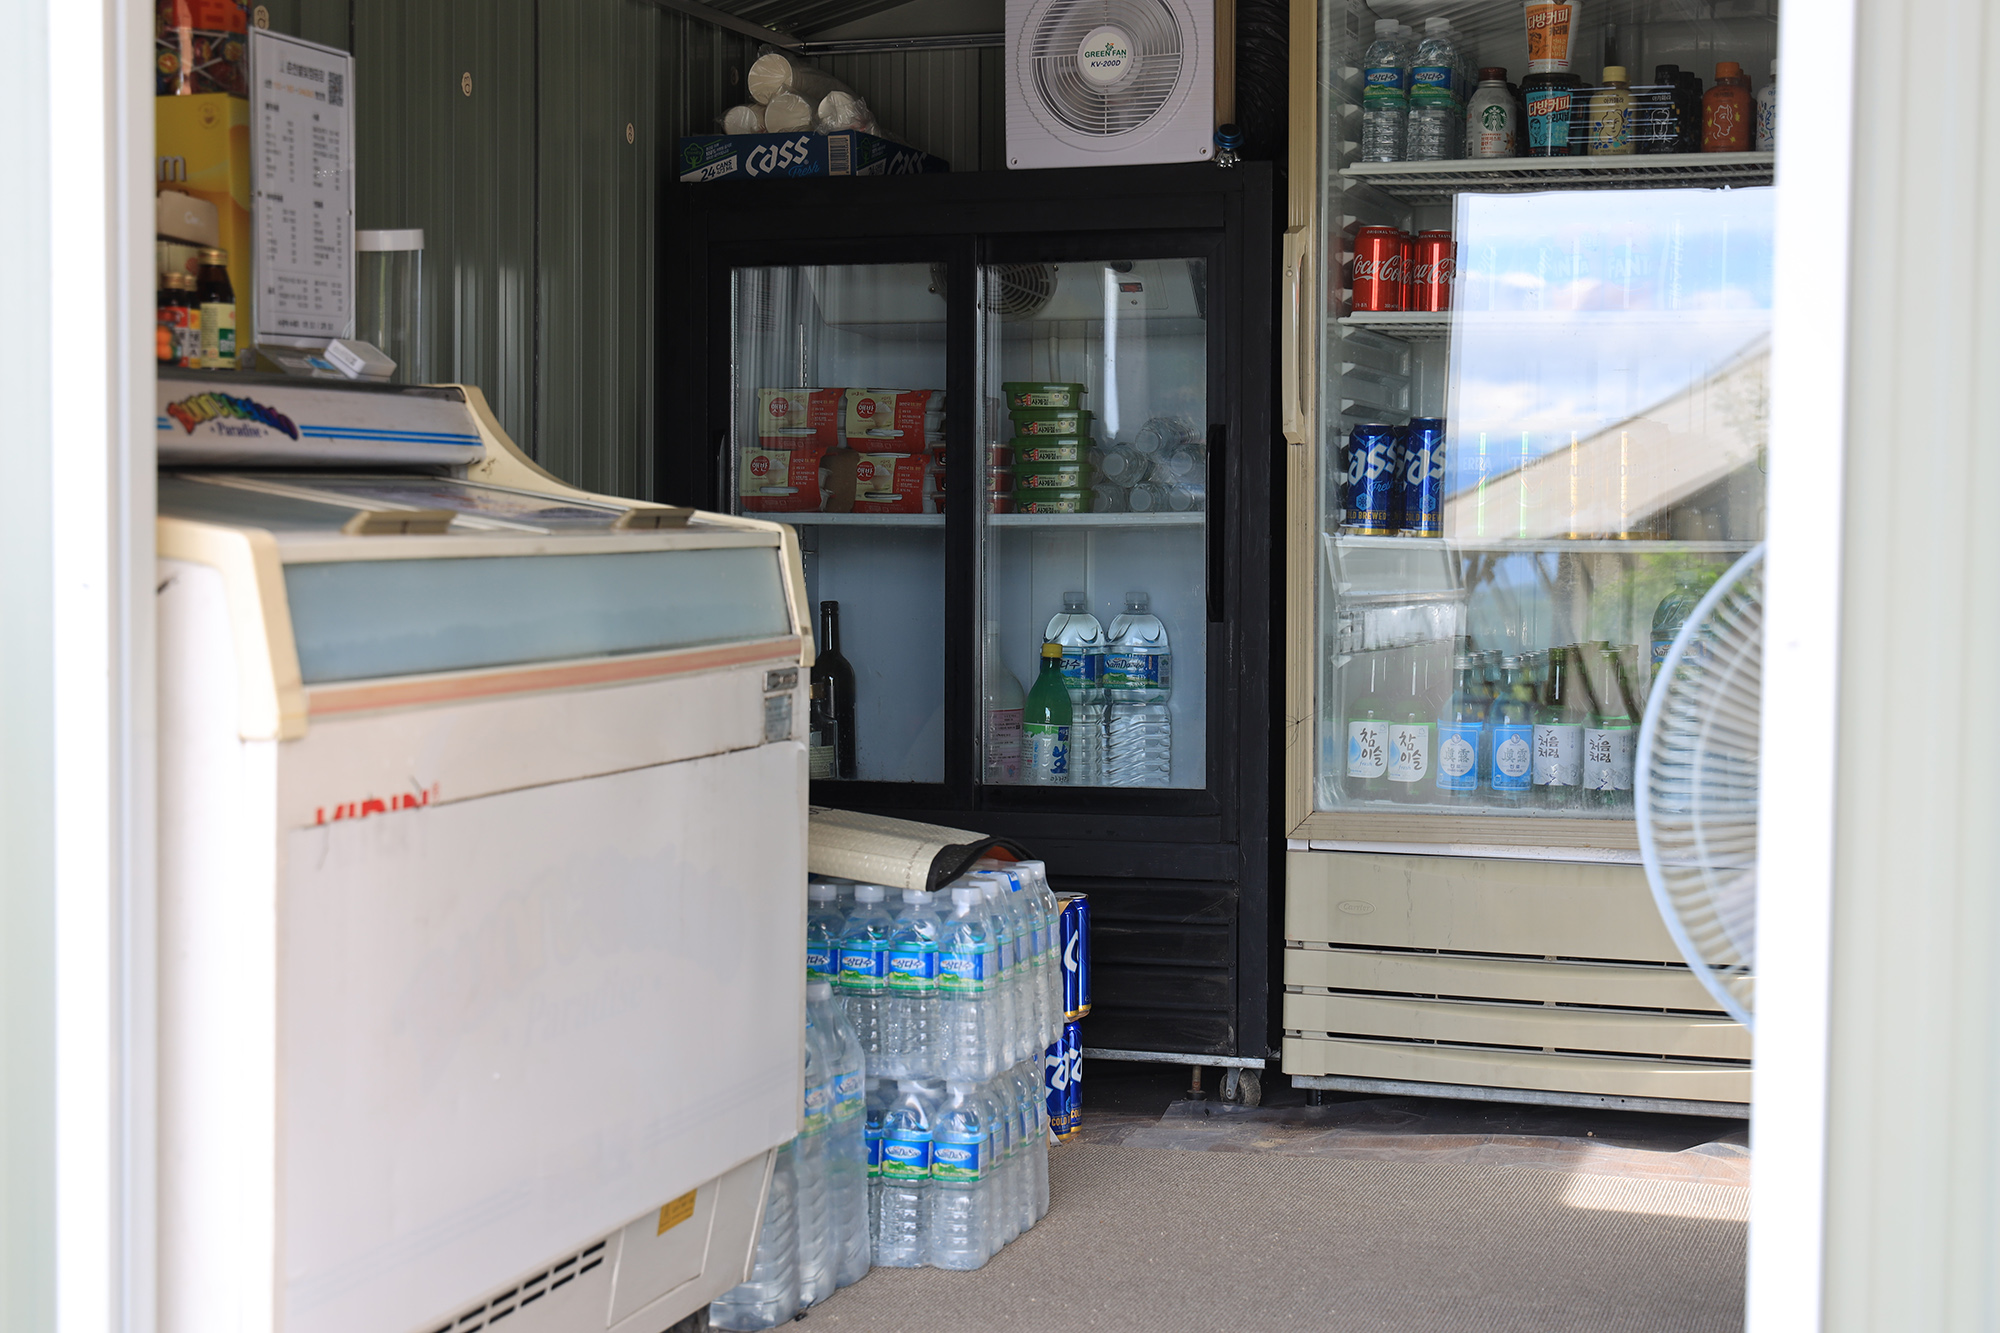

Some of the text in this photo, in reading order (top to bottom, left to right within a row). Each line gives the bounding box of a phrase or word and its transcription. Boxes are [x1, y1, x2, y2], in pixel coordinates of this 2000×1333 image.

[1527, 8, 1569, 30] 다방커피
[1084, 49, 1127, 58] GREEN FAN
[1528, 94, 1571, 117] 다방커피
[716, 159, 732, 170] CANS
[701, 166, 716, 182] 24
[788, 161, 820, 179] Fresh
[857, 404, 875, 414] 햇반
[752, 462, 769, 472] 햇반
[857, 467, 874, 477] 햇반
[1358, 511, 1387, 520] BREWED
[1051, 1116, 1067, 1126] COLD
